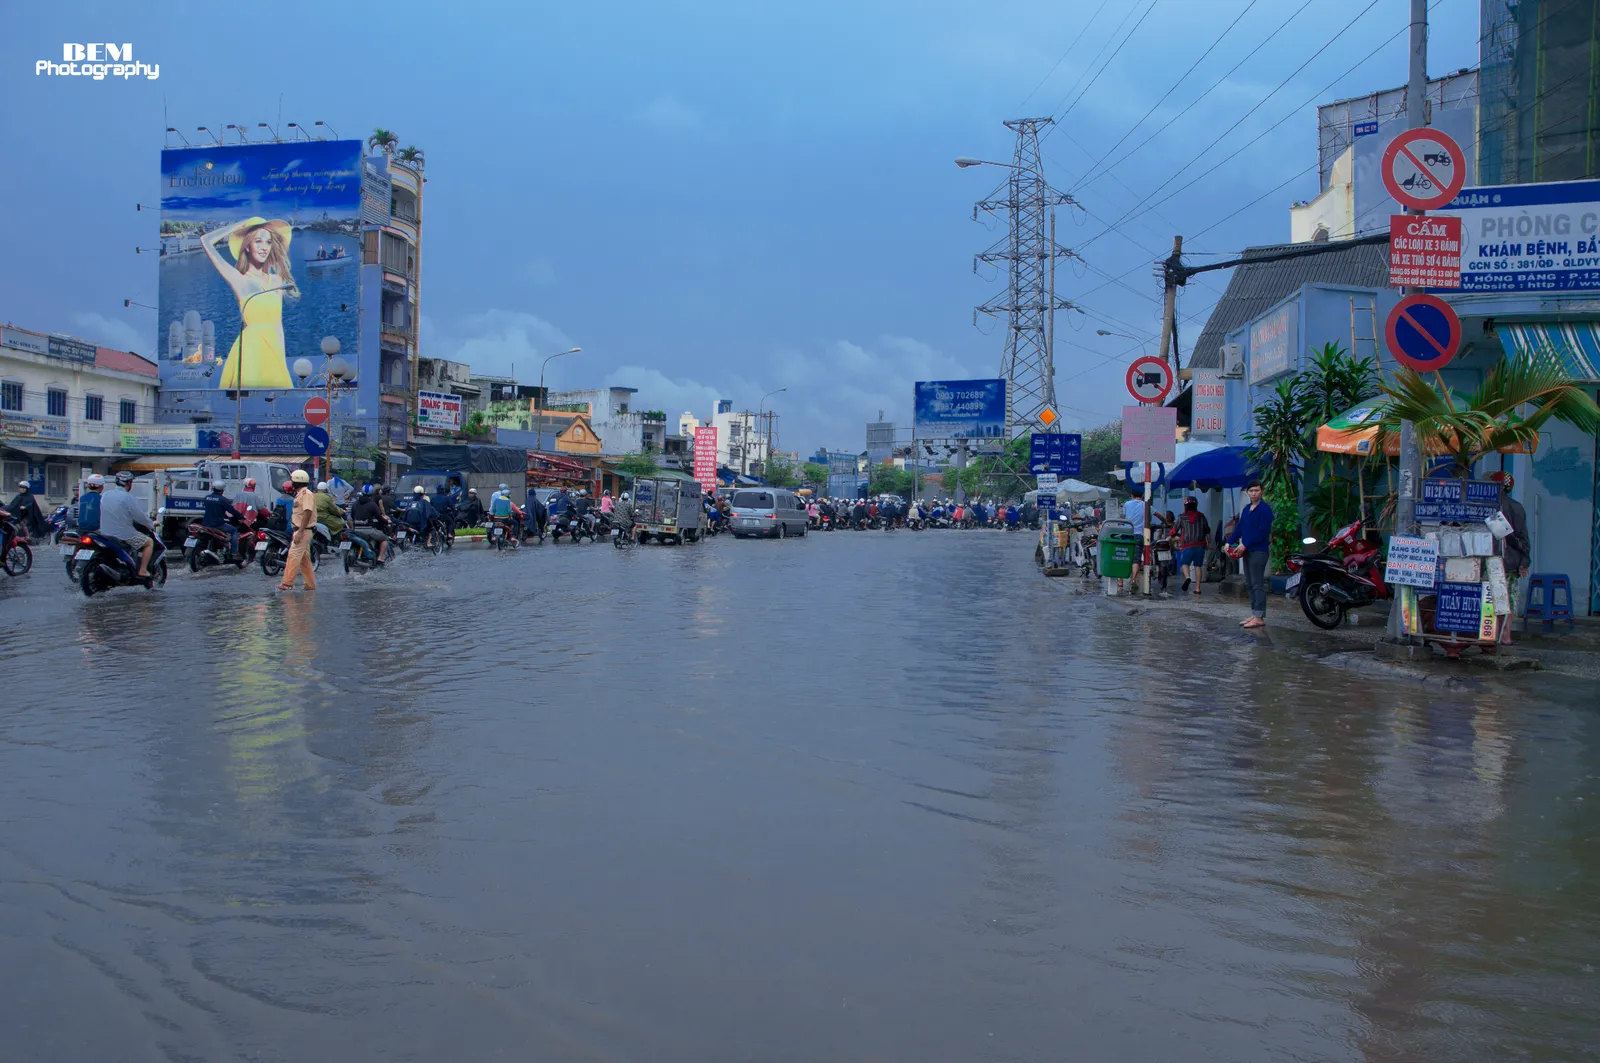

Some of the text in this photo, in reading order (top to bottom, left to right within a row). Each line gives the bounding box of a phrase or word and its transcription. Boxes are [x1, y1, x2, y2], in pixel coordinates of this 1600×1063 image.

[1450, 193, 1501, 206] QUẬN 6
[1407, 219, 1447, 236] CẤM
[1481, 210, 1600, 238] PHÒNG C
[1394, 235, 1407, 249] CÁC
[1409, 238, 1423, 252] LOẠI
[1425, 239, 1433, 251] XE
[1434, 240, 1439, 251] 3
[1478, 241, 1522, 257] KHÁM
[1526, 240, 1572, 260] BỆNH,
[1402, 254, 1410, 265] XE
[1436, 256, 1441, 267] 4
[1442, 253, 1460, 268] BÁNH
[1469, 261, 1491, 270] GCN
[1494, 257, 1508, 270] SỐ
[1517, 256, 1553, 270] 381/QĐ
[1563, 258, 1600, 267] QLDVY
[1527, 281, 1555, 289] http
[936, 392, 954, 400] 0903
[1196, 417, 1205, 430] DA
[1441, 592, 1460, 610] TUẤN
[1484, 615, 1492, 636] 1668
